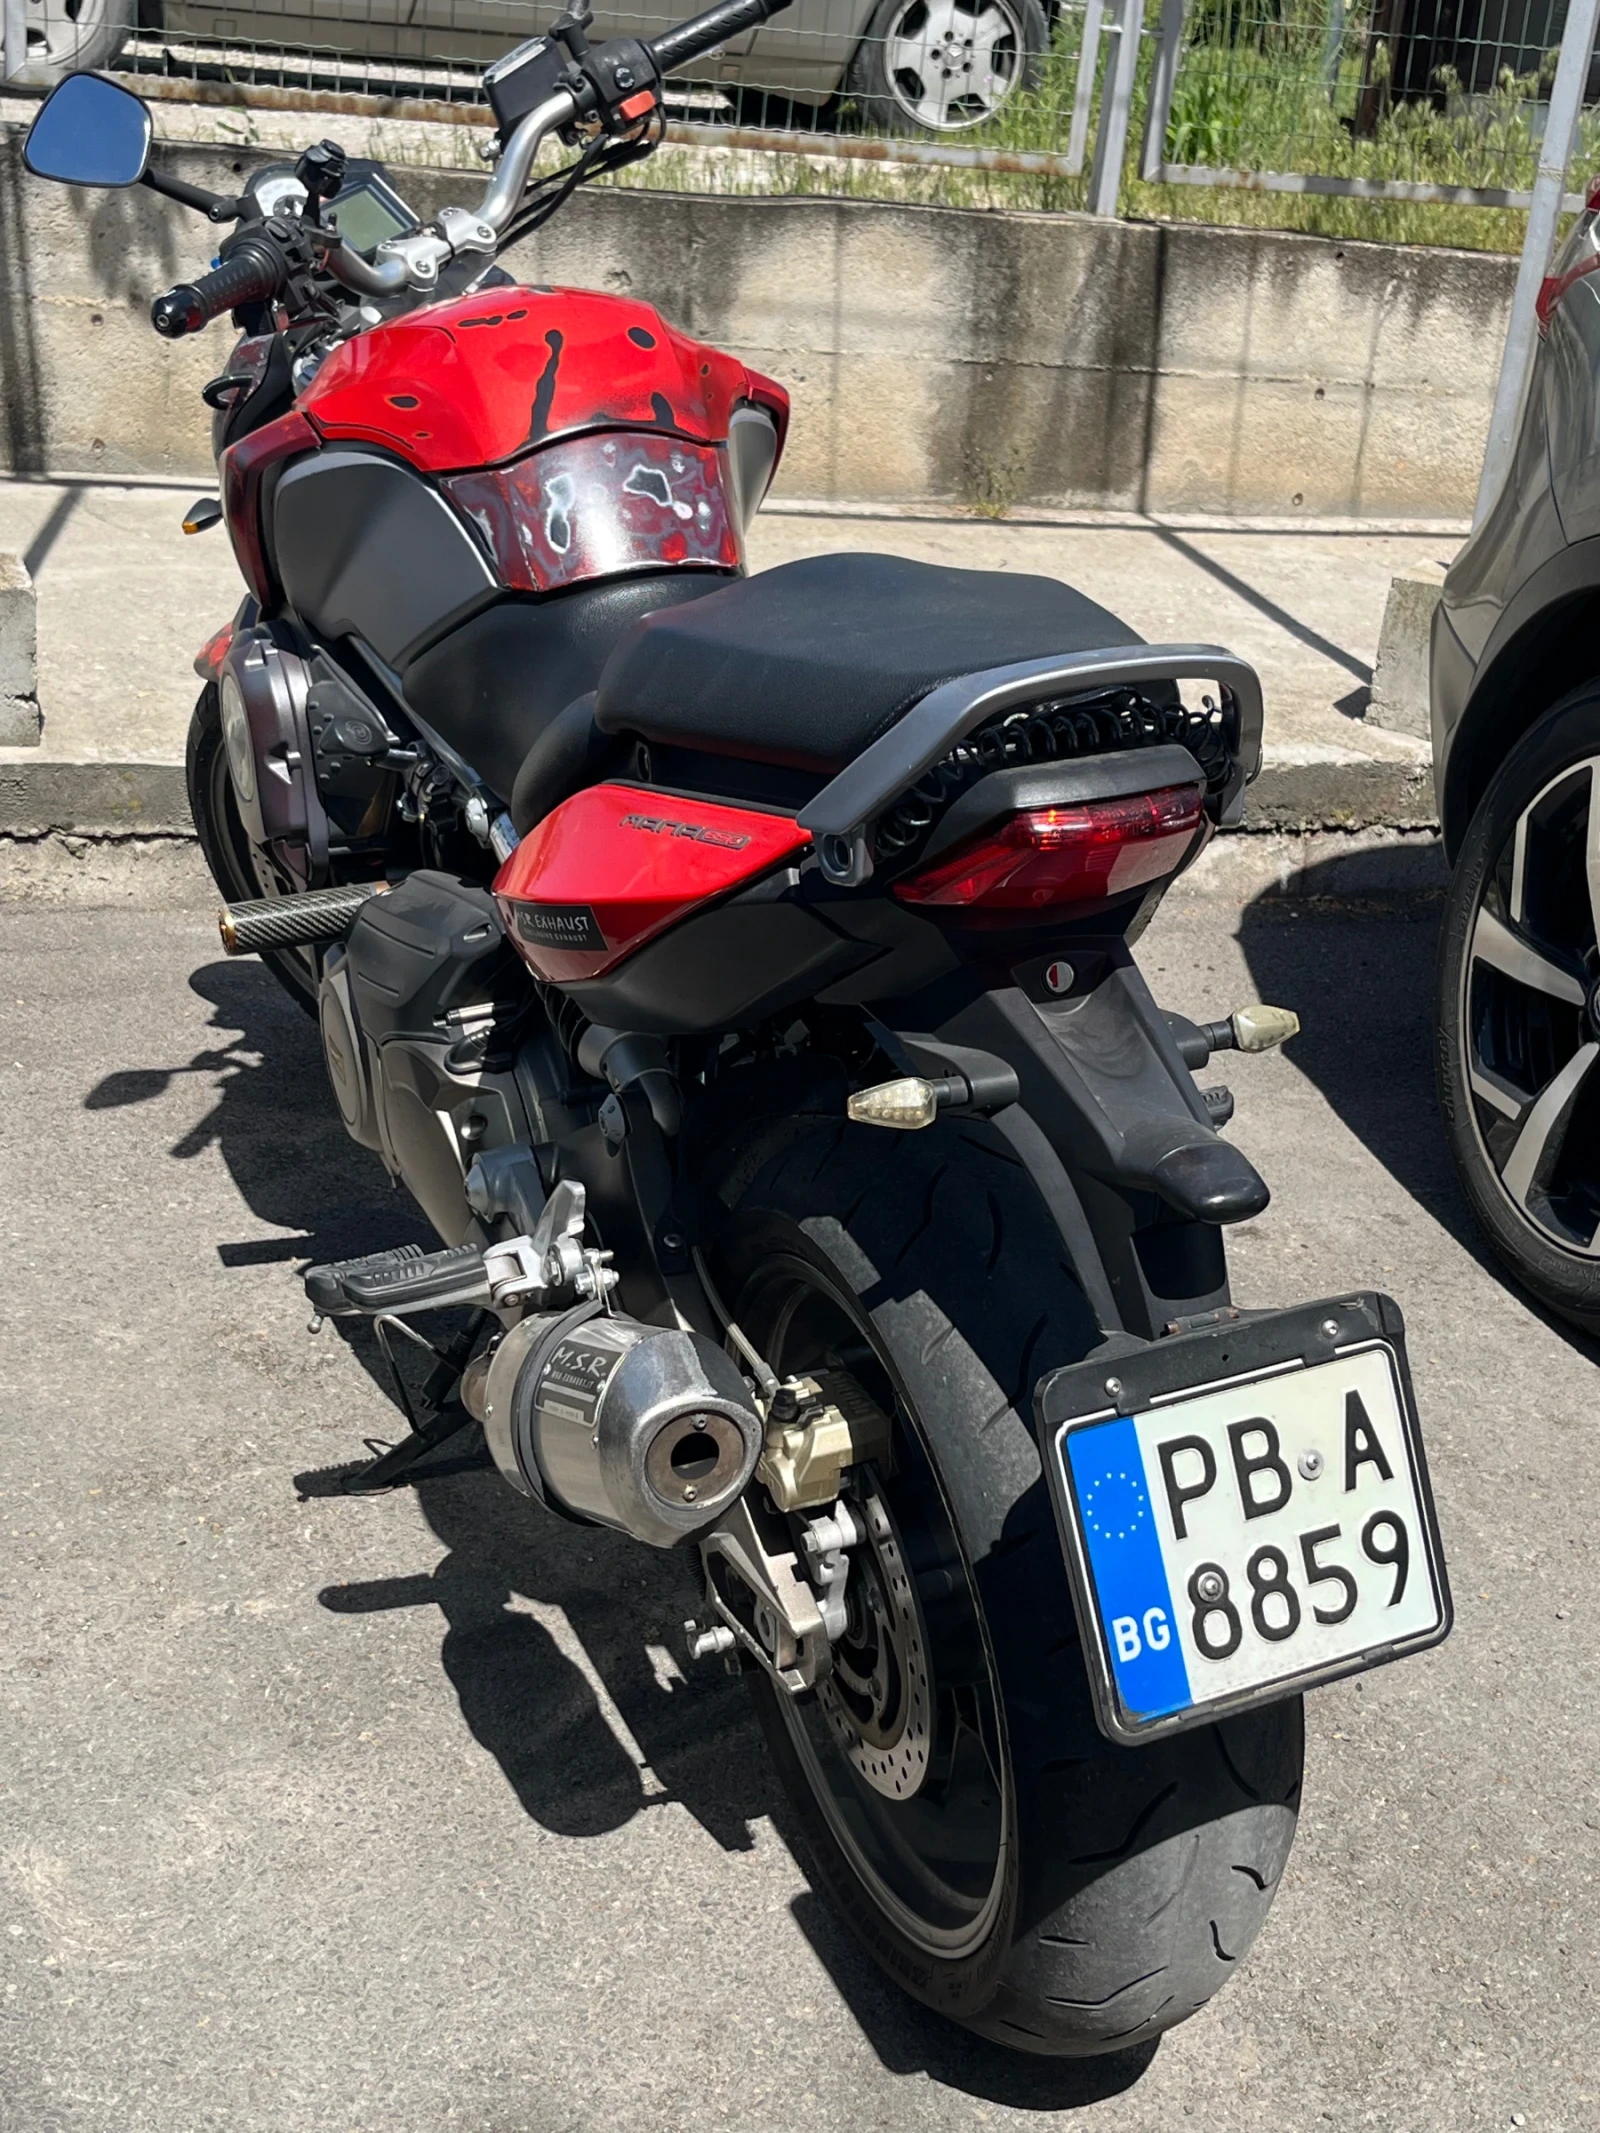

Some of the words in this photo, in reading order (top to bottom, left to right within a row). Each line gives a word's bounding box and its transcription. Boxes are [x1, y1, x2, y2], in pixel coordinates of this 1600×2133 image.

[534, 914, 590, 932] EXHAUST
[1186, 1509, 1410, 1662] 8859
[1111, 1606, 1171, 1663] BG
